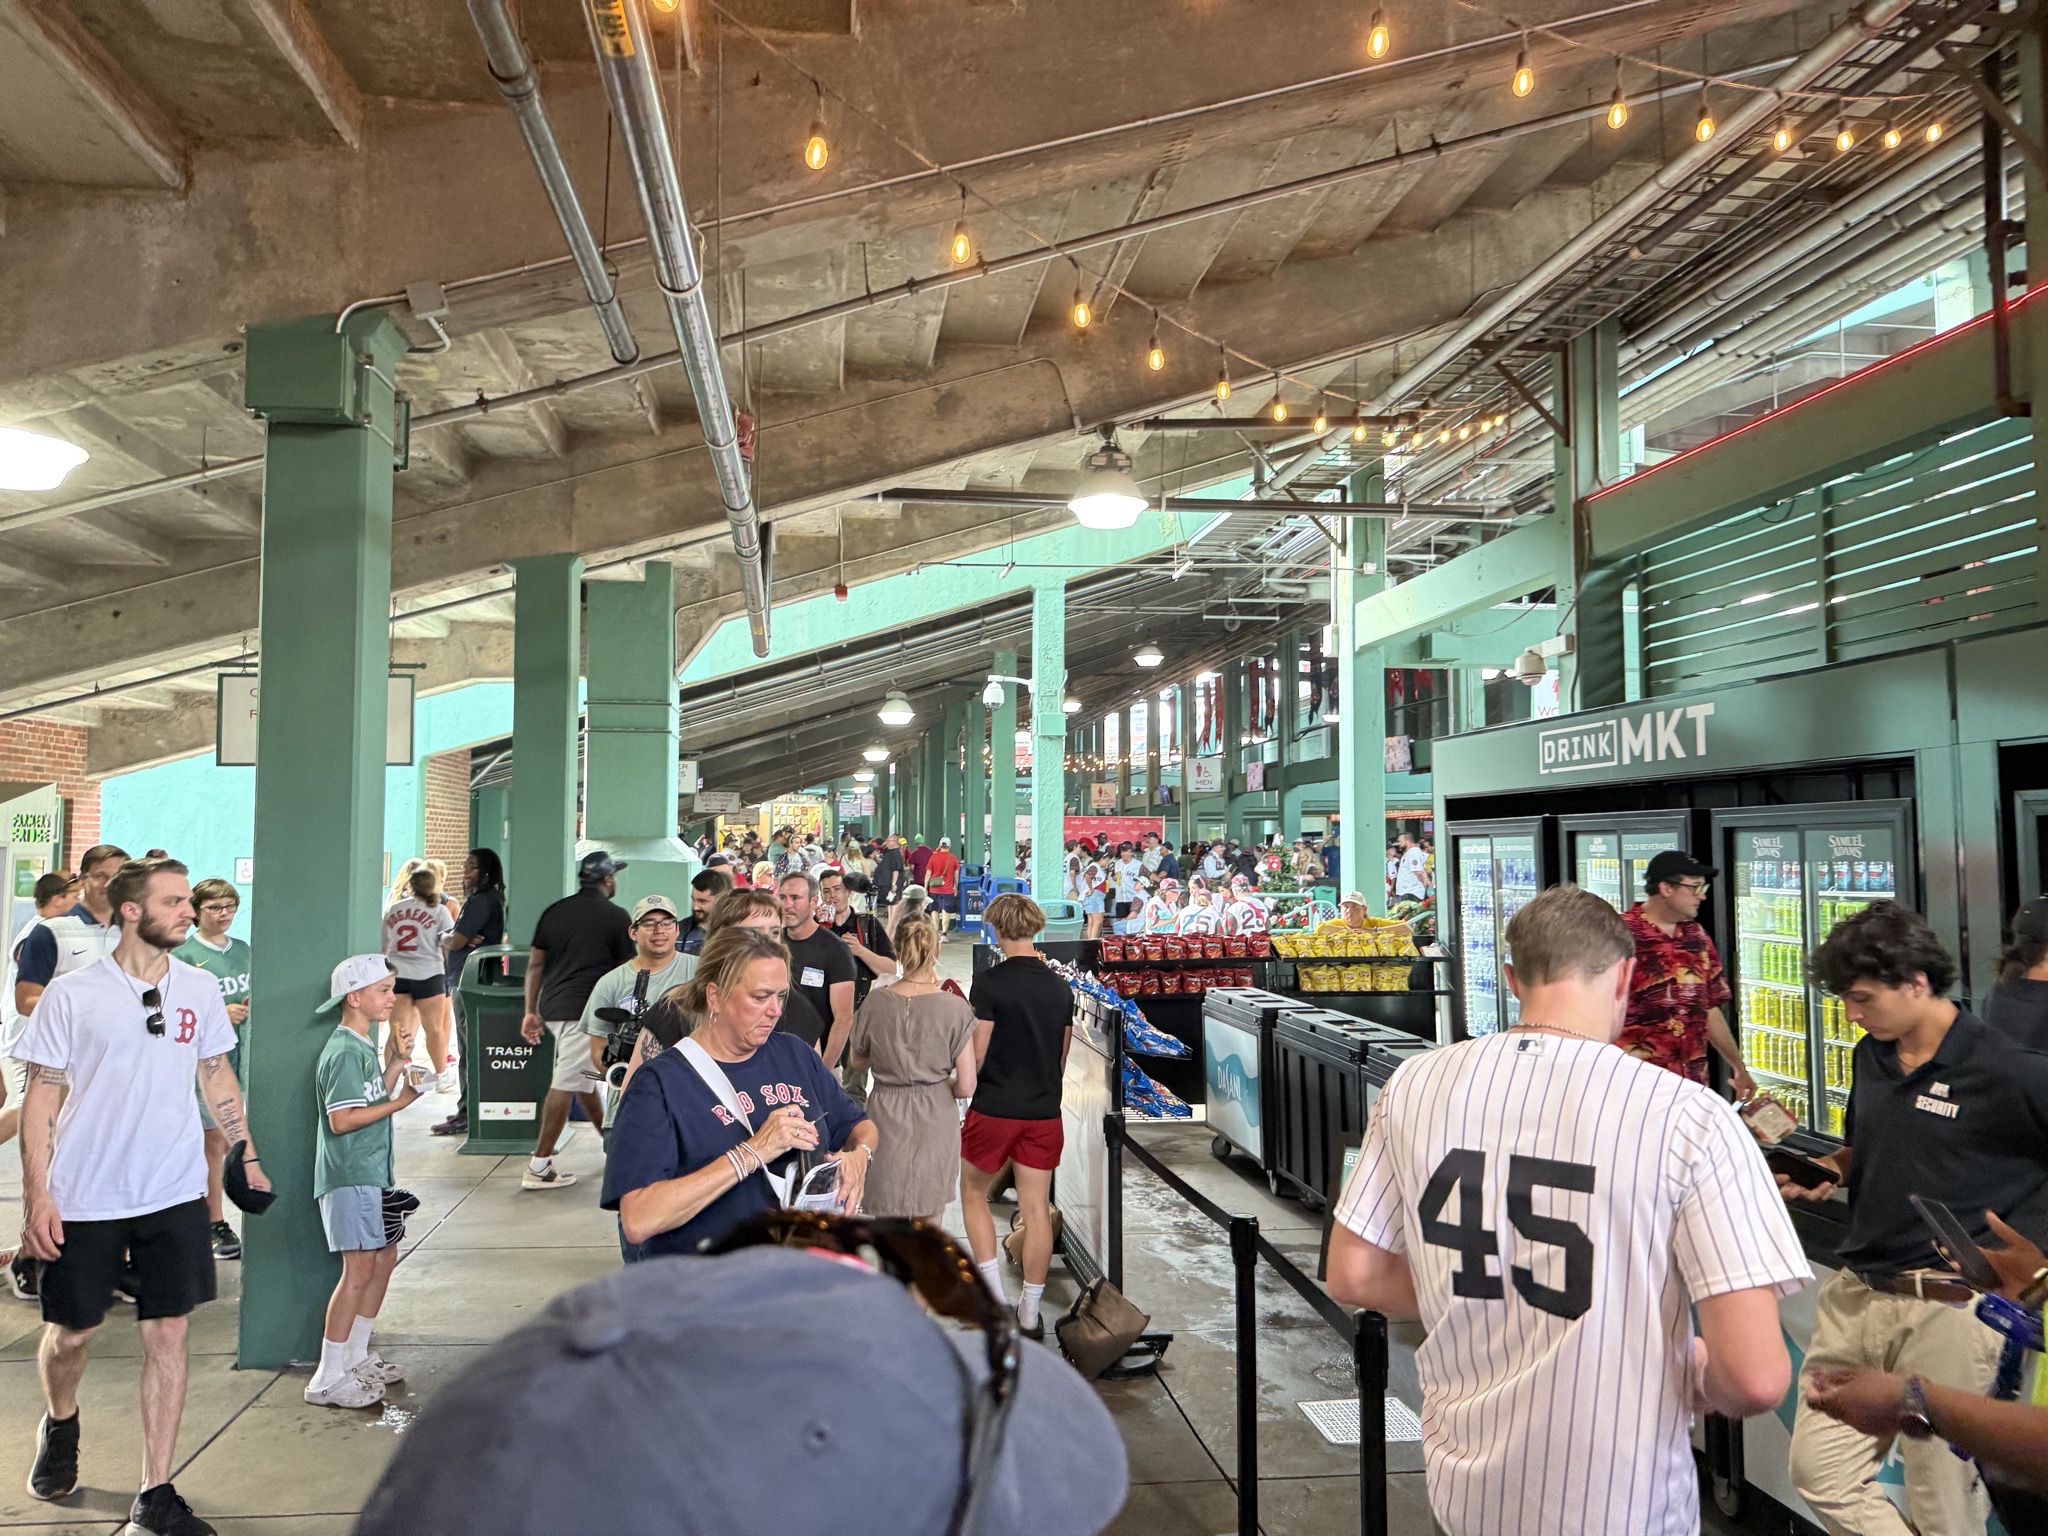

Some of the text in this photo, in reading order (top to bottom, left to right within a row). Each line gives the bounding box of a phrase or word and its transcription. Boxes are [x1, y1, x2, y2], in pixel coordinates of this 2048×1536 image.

[1543, 702, 1715, 765] DRINK MKT
[12, 829, 51, 843] FRIDGE
[1752, 836, 1783, 849] SAMUEL
[1828, 834, 1866, 848] SAMUEL
[1640, 842, 1676, 851] BEVERAGES
[1755, 847, 1781, 859] ADAMS
[1832, 846, 1863, 859] ADAMS
[397, 924, 418, 951] 2
[175, 1007, 198, 1044] B
[485, 1046, 533, 1056] TRASH
[491, 1060, 528, 1070] ONLY
[711, 1082, 810, 1126] RD SOX
[1915, 1094, 1960, 1119] SECURITY
[1417, 1147, 1597, 1322] 45
